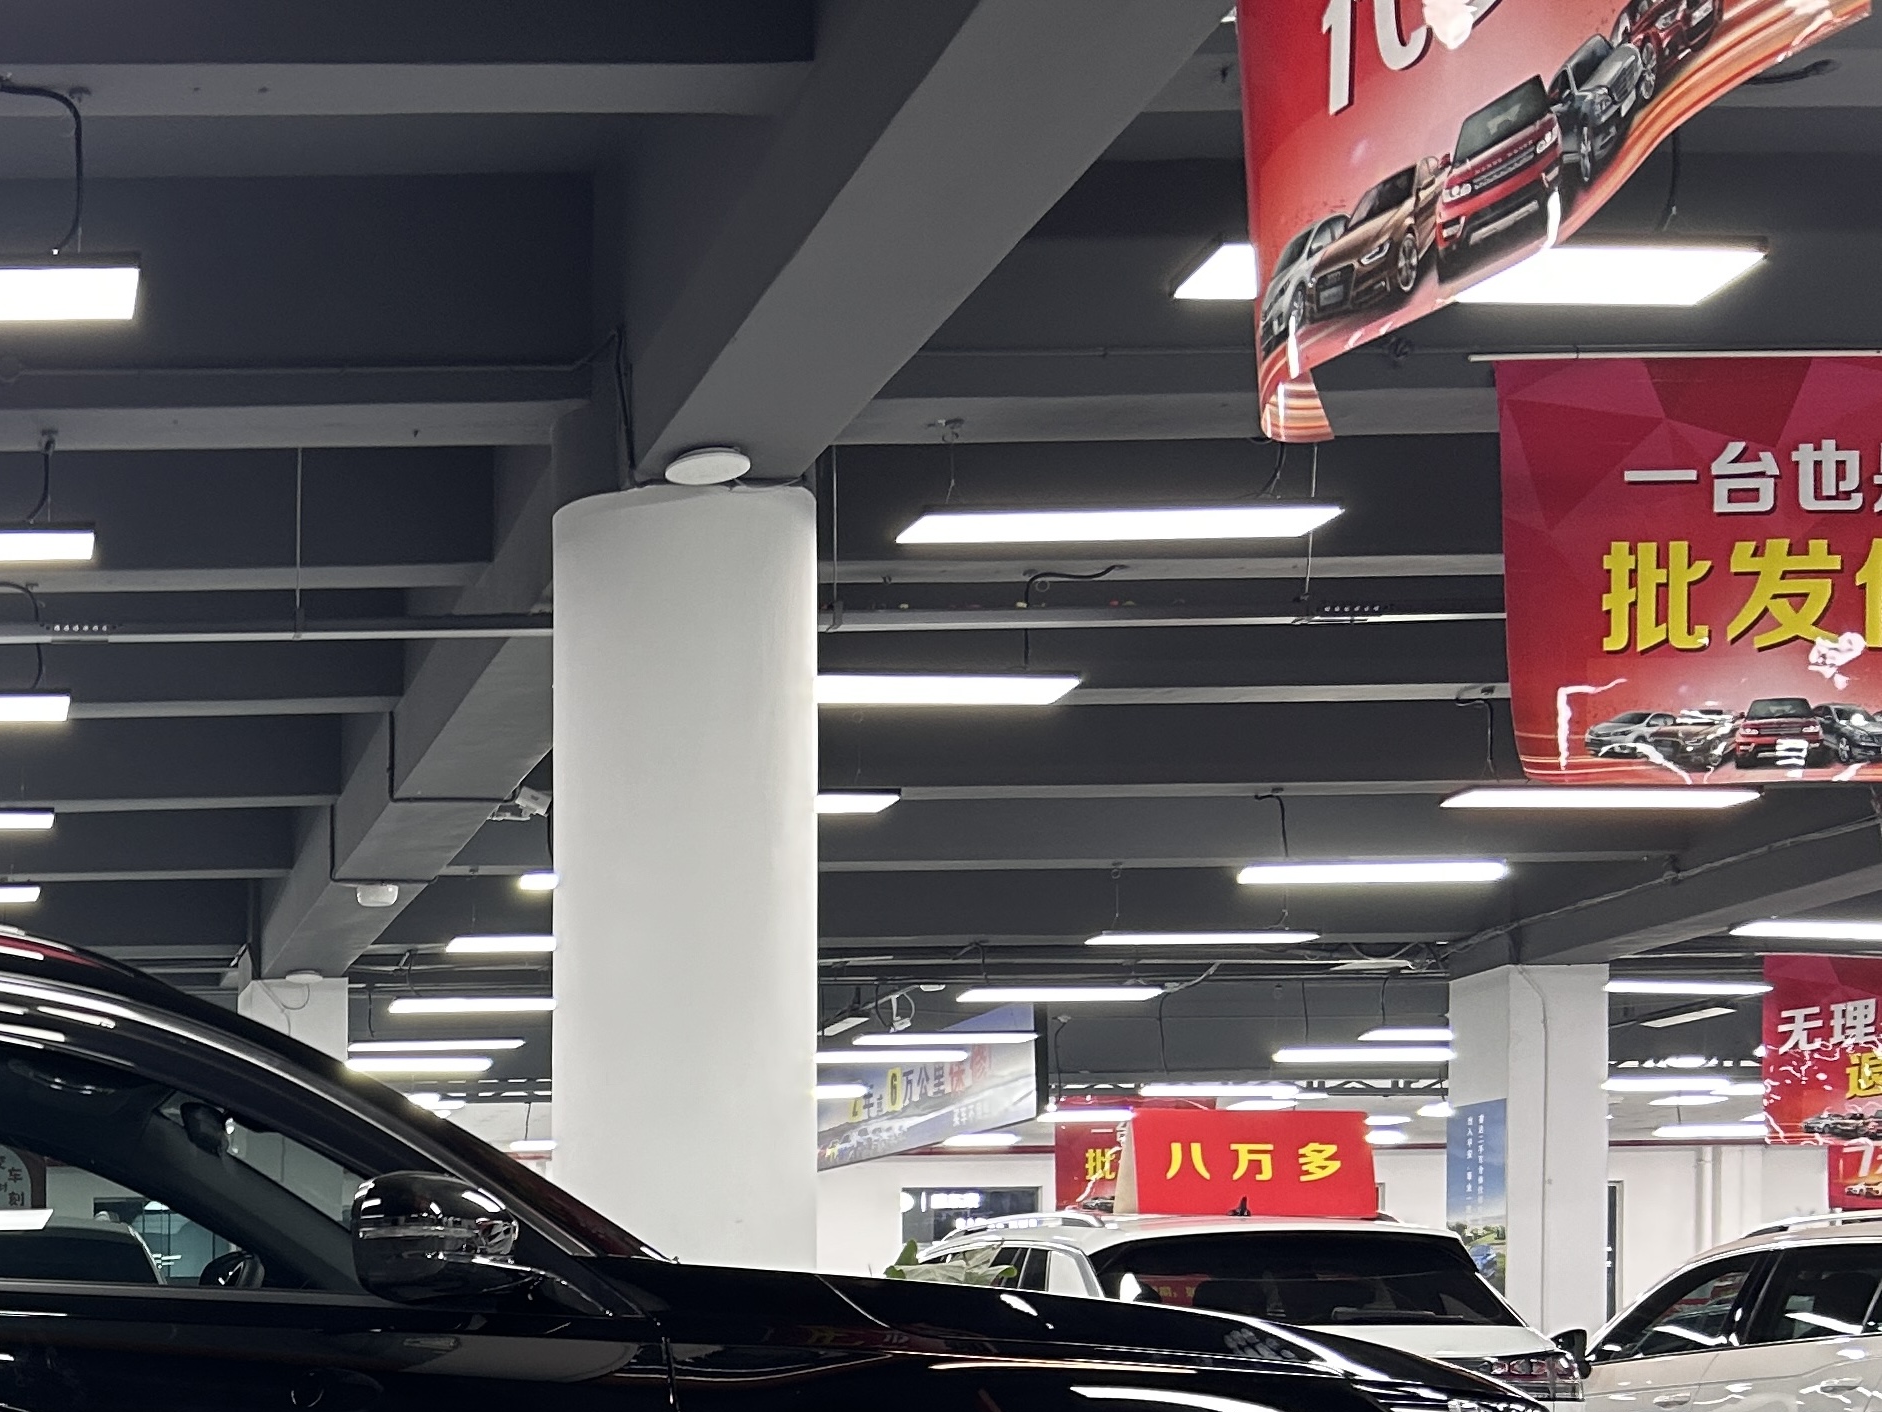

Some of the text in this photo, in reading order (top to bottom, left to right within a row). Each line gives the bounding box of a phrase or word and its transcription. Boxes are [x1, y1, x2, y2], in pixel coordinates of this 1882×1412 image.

[1624, 439, 1882, 514] 一台也
[1166, 1142, 1342, 1182] 八万多
